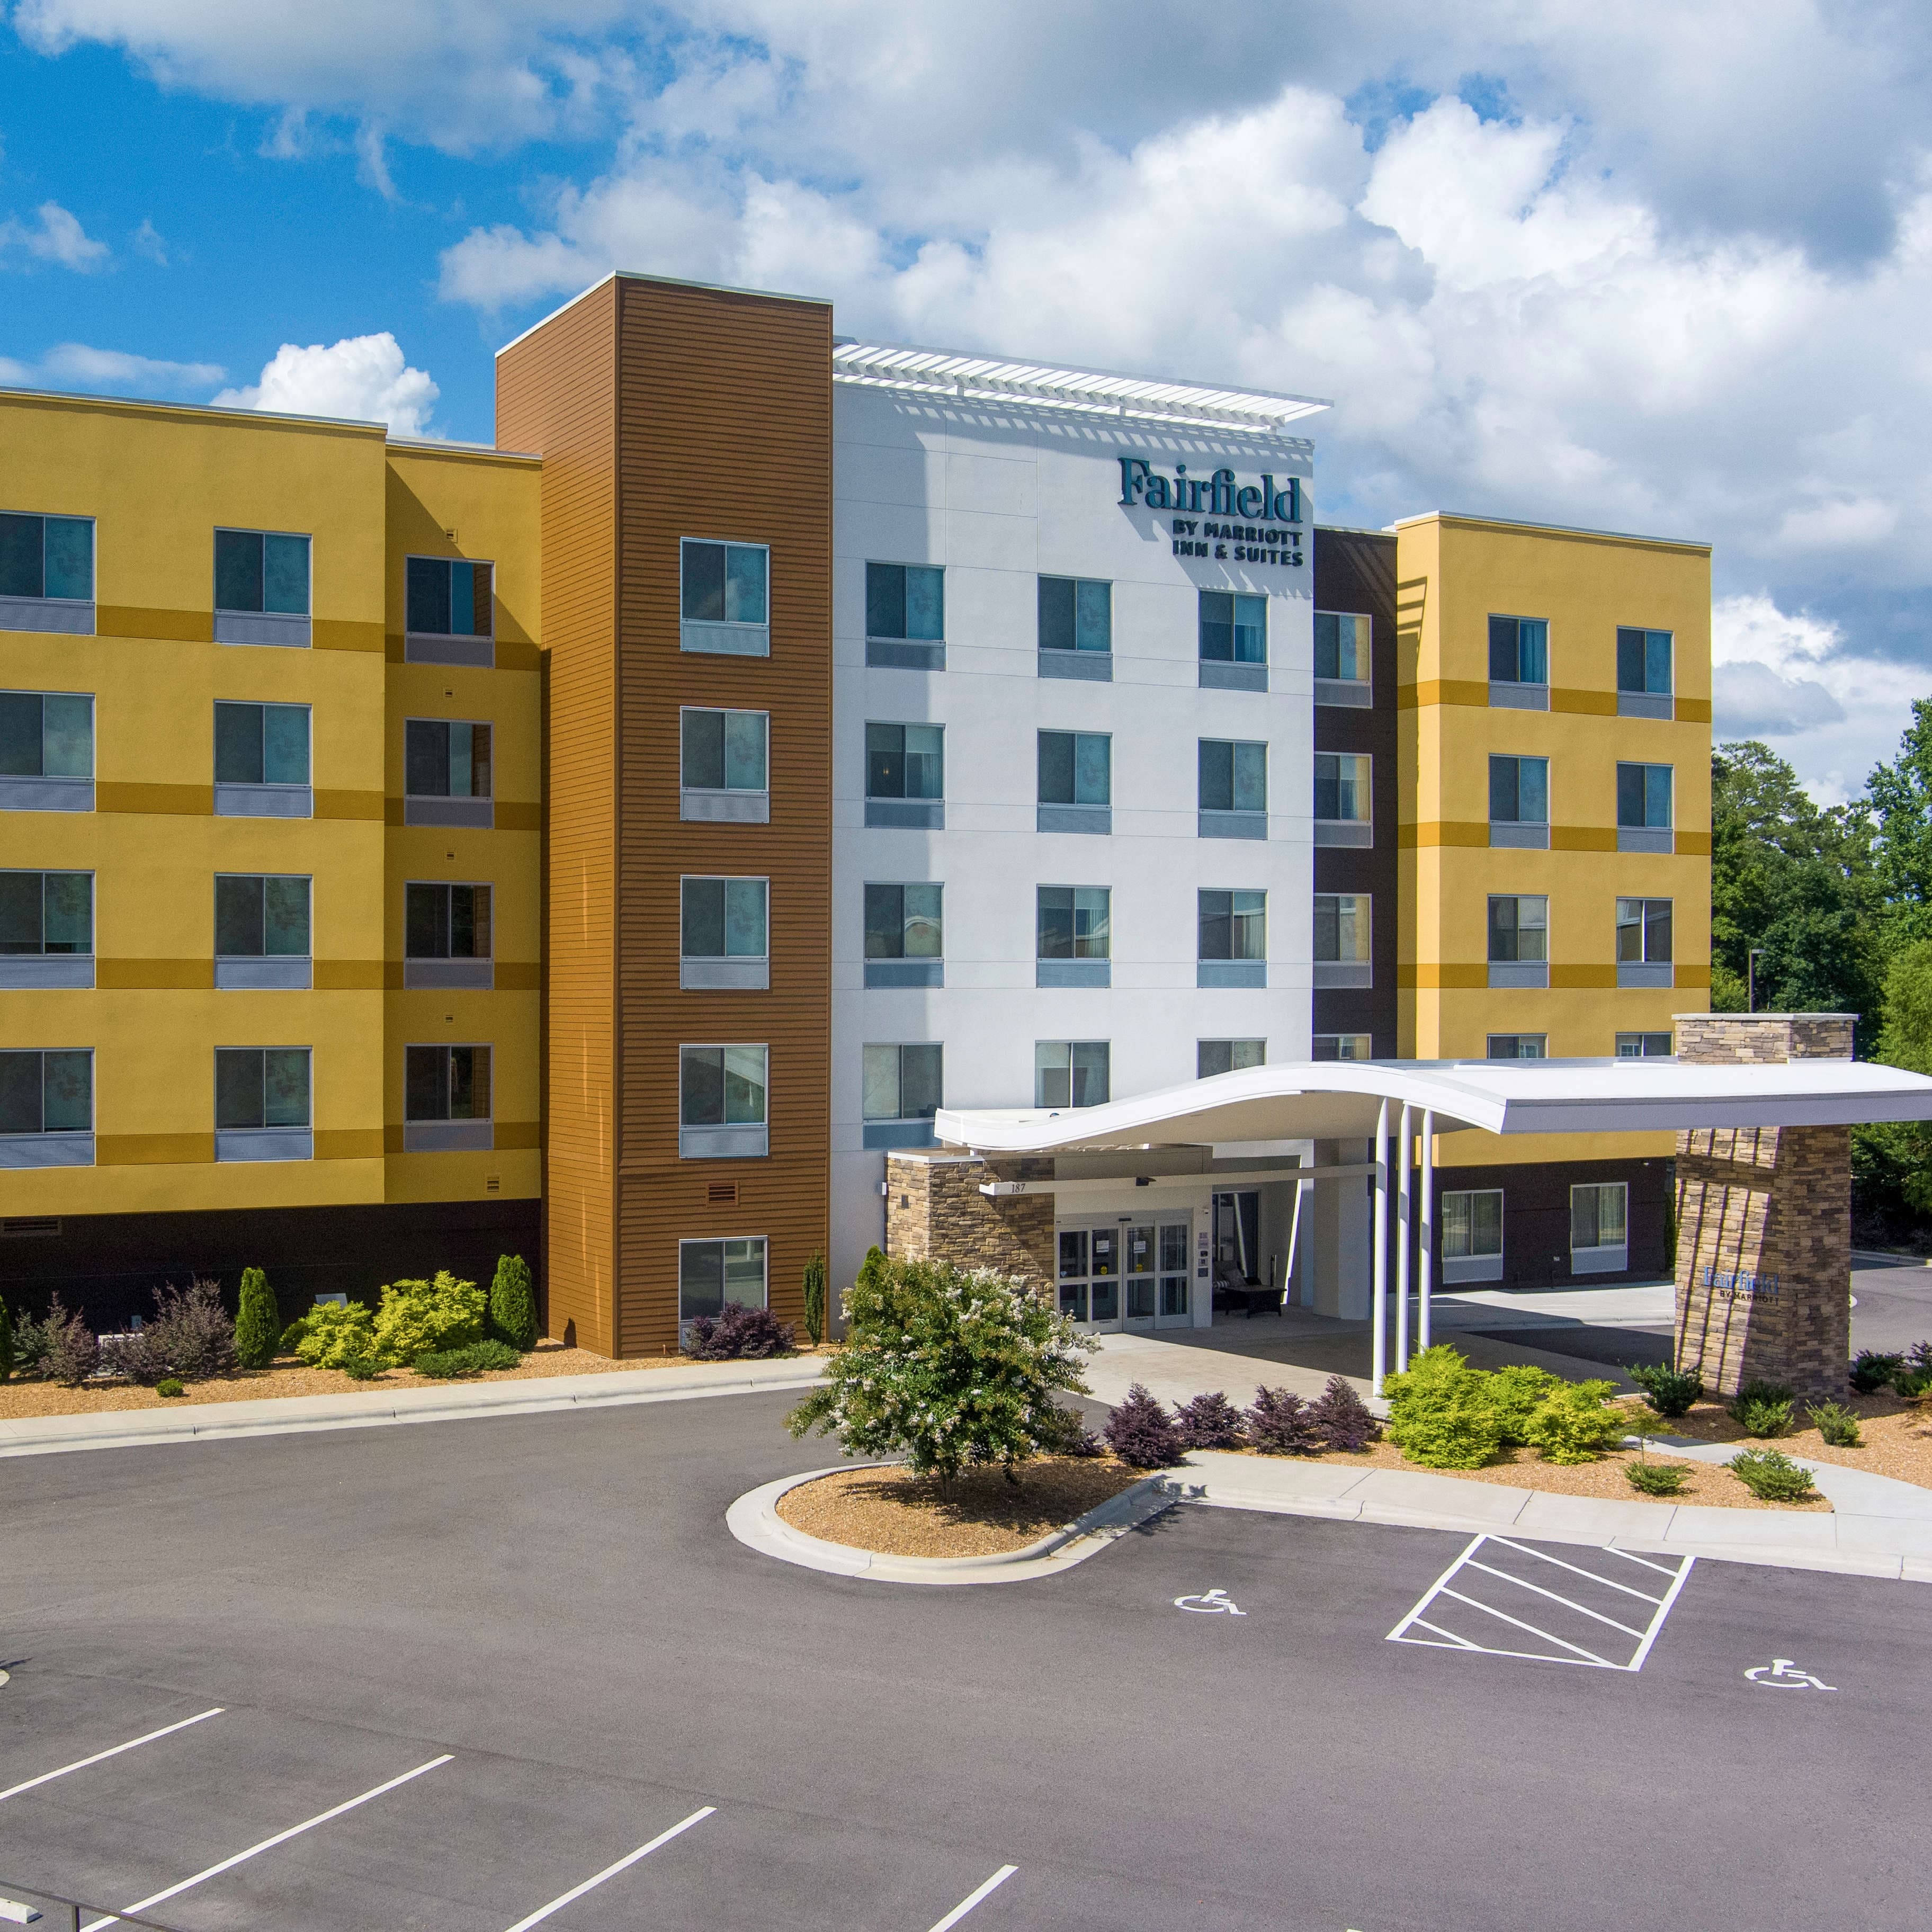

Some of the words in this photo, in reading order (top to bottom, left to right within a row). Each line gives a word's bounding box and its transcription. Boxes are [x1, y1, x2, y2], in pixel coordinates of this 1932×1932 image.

[1117, 457, 1303, 523] Fairfield
[1173, 519, 1199, 536] BY
[1203, 522, 1303, 547] MARRIOTT
[1172, 540, 1208, 557] INN
[1214, 544, 1228, 559] &
[1234, 545, 1303, 567] SUITES
[1012, 1183, 1026, 1193] 187
[1703, 1266, 1779, 1294] Fairfield
[1734, 1292, 1779, 1306] MARRIOTT
